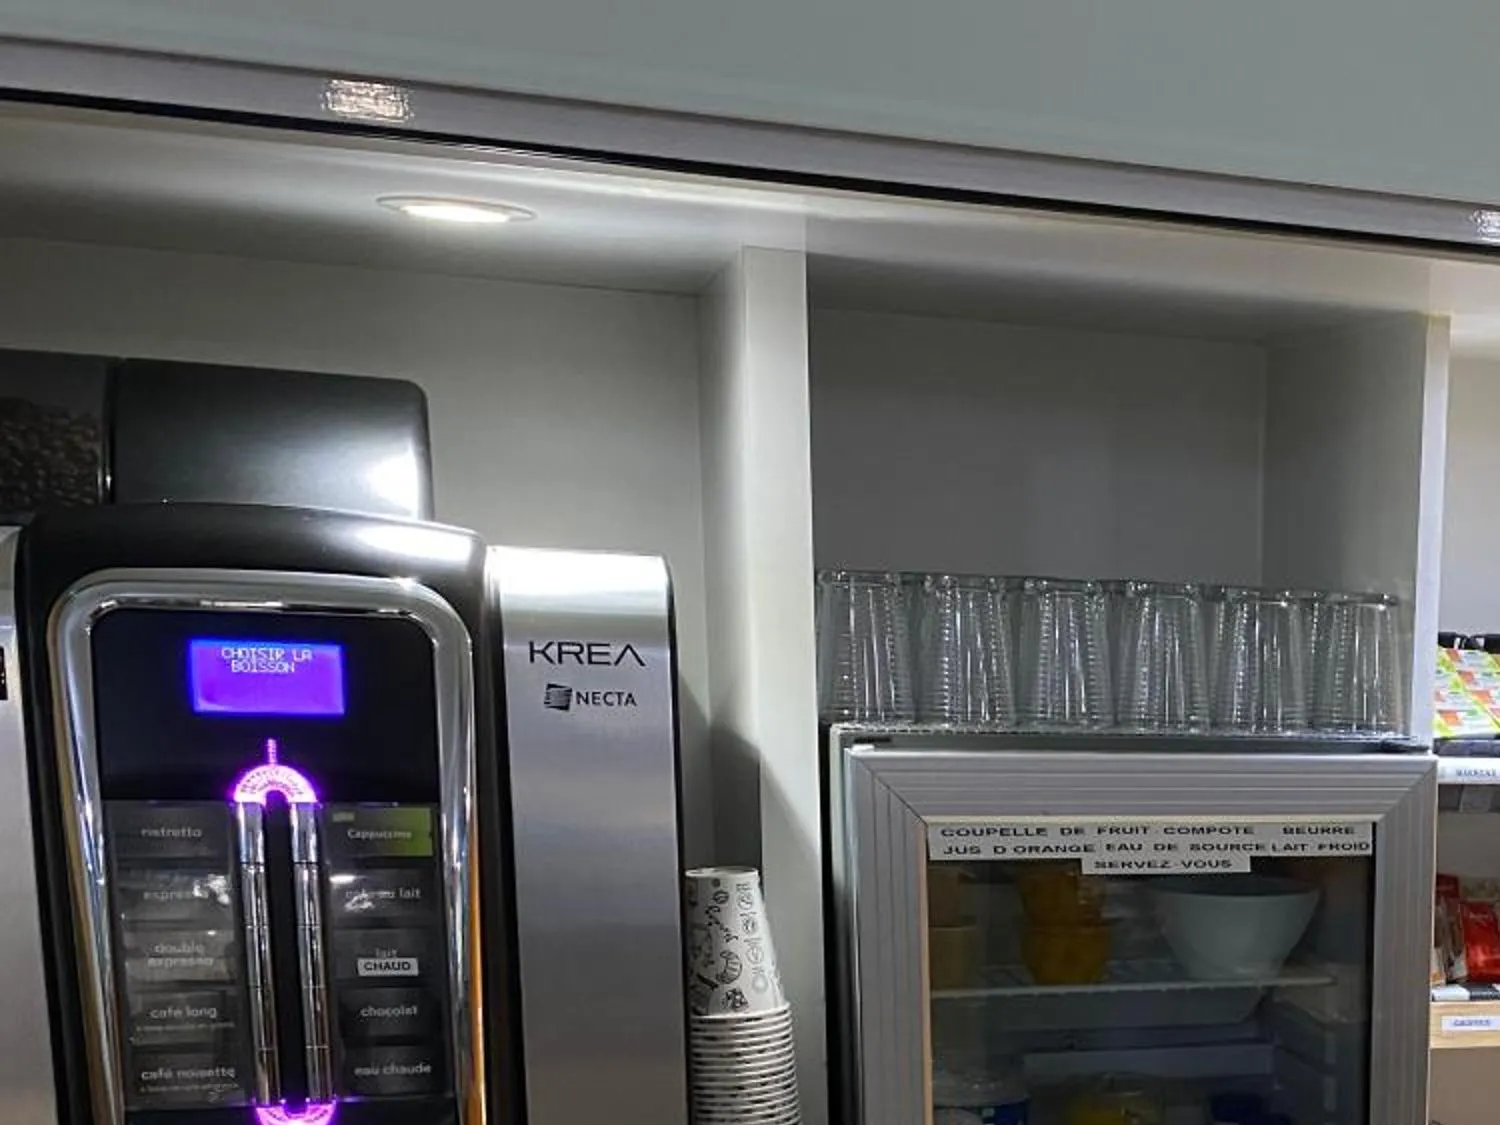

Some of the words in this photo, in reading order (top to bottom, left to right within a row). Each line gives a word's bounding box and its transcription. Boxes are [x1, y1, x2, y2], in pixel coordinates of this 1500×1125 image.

[221, 647, 285, 661] CHOISIR
[292, 649, 314, 662] LA
[528, 640, 647, 667] KREA
[231, 660, 296, 673] BOISSON
[576, 691, 638, 707] NECTA
[140, 827, 203, 838] ristretto
[940, 827, 1049, 838] COUPELLE
[1060, 827, 1085, 837] DE
[1097, 826, 1150, 836] FRUIT
[1163, 826, 1255, 836] COMPOTE
[1283, 826, 1356, 836] BEURRE
[943, 845, 982, 855] JUS
[1105, 842, 1143, 852] EAU
[1153, 842, 1178, 852] DE
[1189, 842, 1266, 852] SOURCE
[1271, 842, 1308, 852] LAIT
[1317, 841, 1370, 851] FROID
[363, 961, 412, 972] CHAUD
[185, 1005, 217, 1019] long
[360, 1005, 418, 1017] chocolat
[354, 1066, 380, 1076] eau
[383, 1062, 432, 1075] chaude
